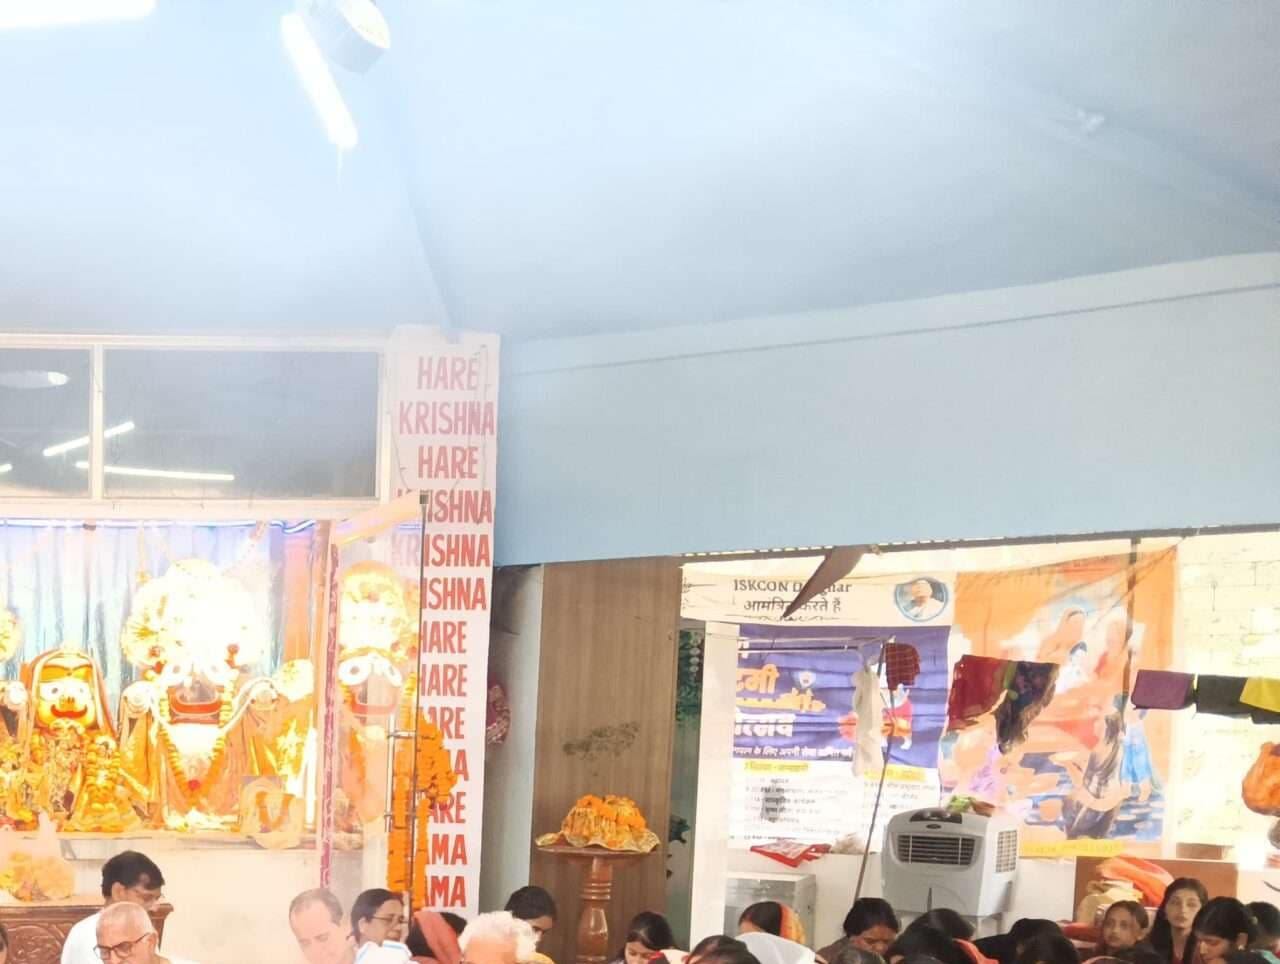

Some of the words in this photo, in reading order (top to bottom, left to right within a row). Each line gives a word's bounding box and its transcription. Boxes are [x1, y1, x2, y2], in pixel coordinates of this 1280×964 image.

[417, 356, 478, 391] HARE
[399, 400, 495, 436] KRISHNA
[418, 445, 478, 479] HARE
[397, 489, 492, 523] ISHNA
[420, 577, 487, 610] ISHNA
[734, 580, 788, 592] ISKCON
